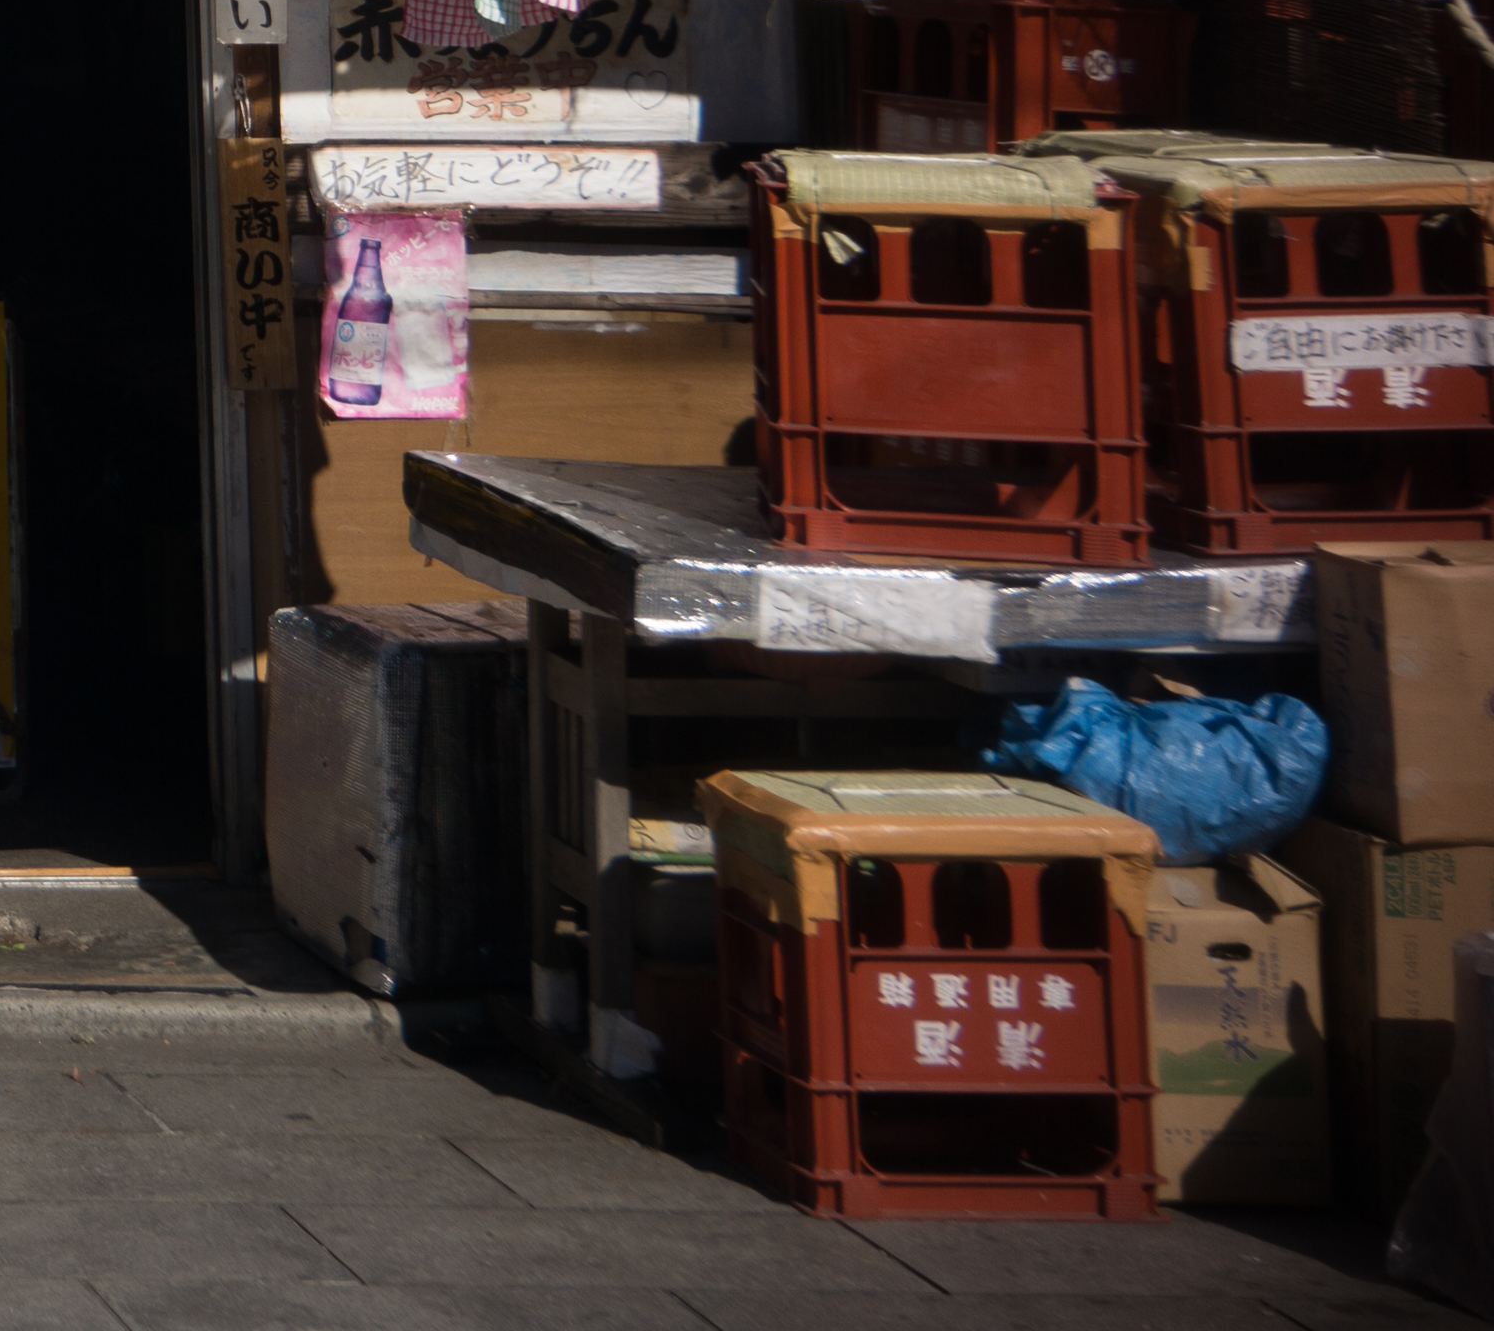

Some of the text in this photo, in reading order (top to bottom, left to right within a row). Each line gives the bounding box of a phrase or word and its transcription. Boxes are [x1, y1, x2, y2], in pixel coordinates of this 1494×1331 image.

[407, 56, 598, 122] 営業中
[232, 197, 284, 339] 商い中
[878, 973, 1077, 1010] 専用通箱
[914, 1020, 1046, 1071] 清酒
